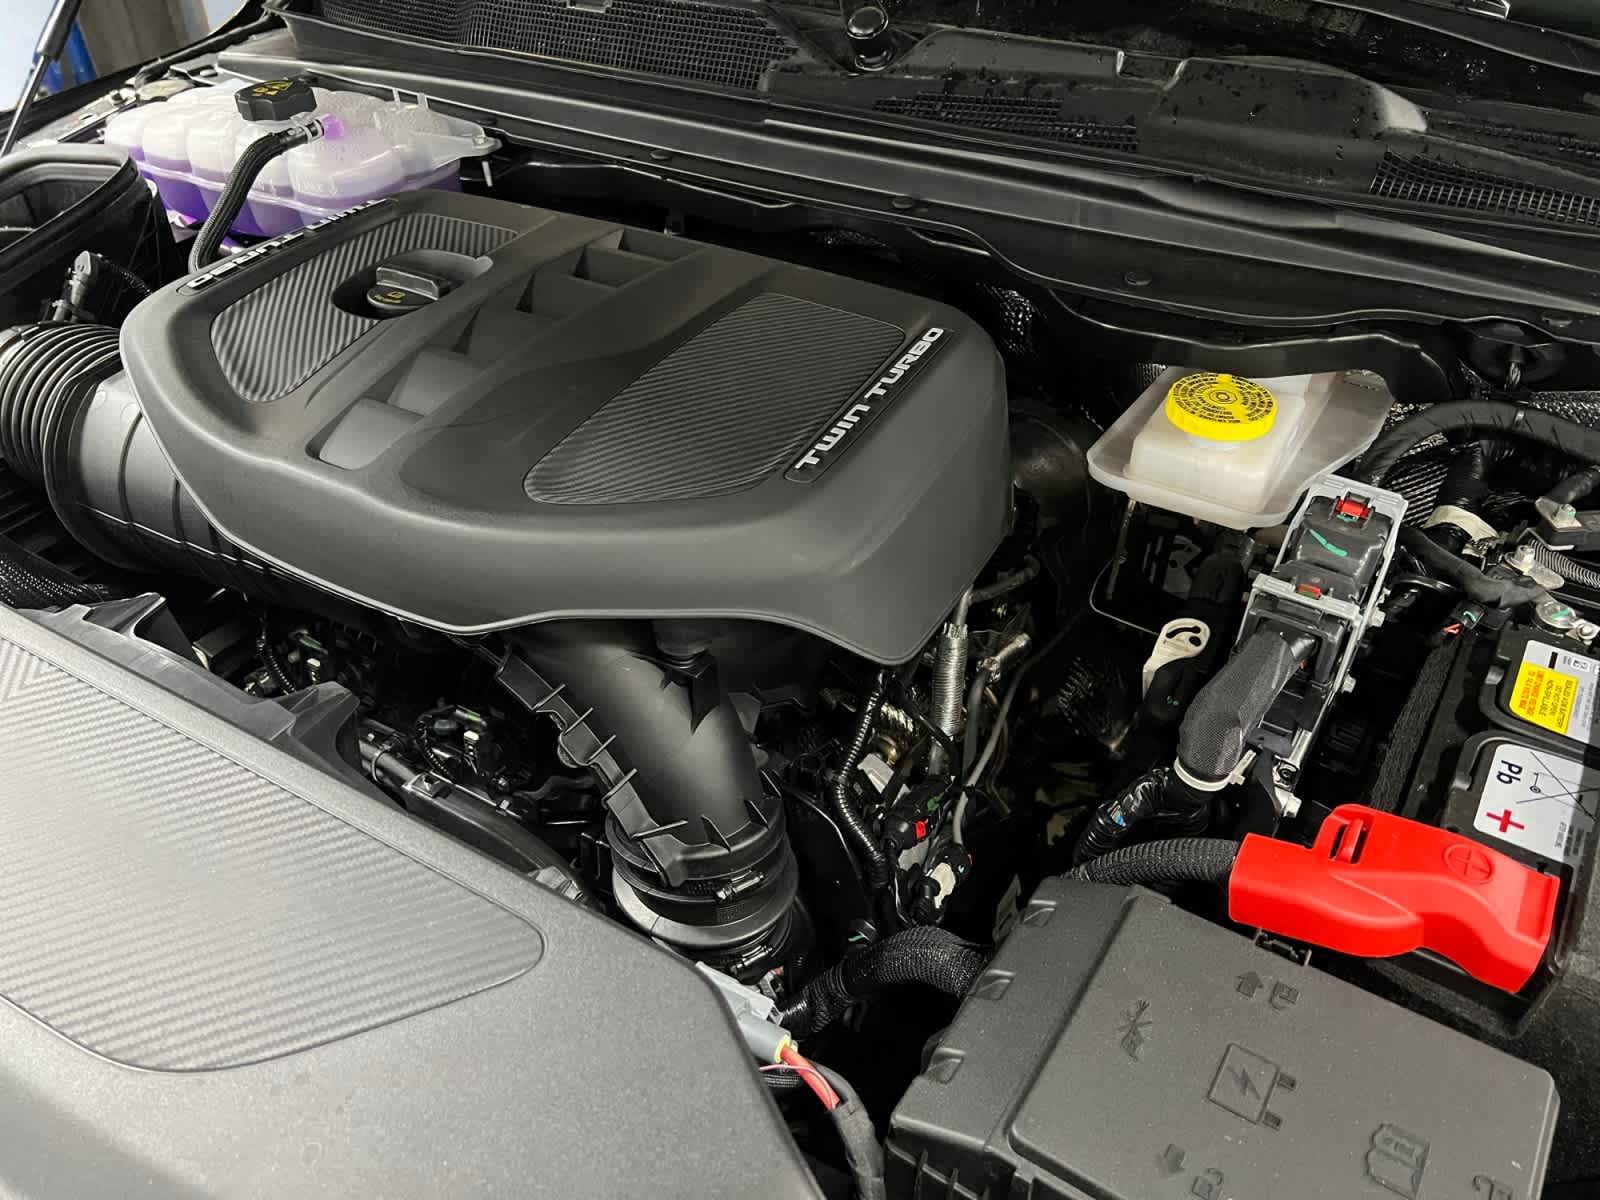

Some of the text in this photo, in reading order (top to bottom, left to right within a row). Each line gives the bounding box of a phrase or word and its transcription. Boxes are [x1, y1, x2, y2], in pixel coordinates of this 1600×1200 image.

[795, 327, 945, 469] TWIN TURBO
[1496, 759, 1523, 785] Pb
